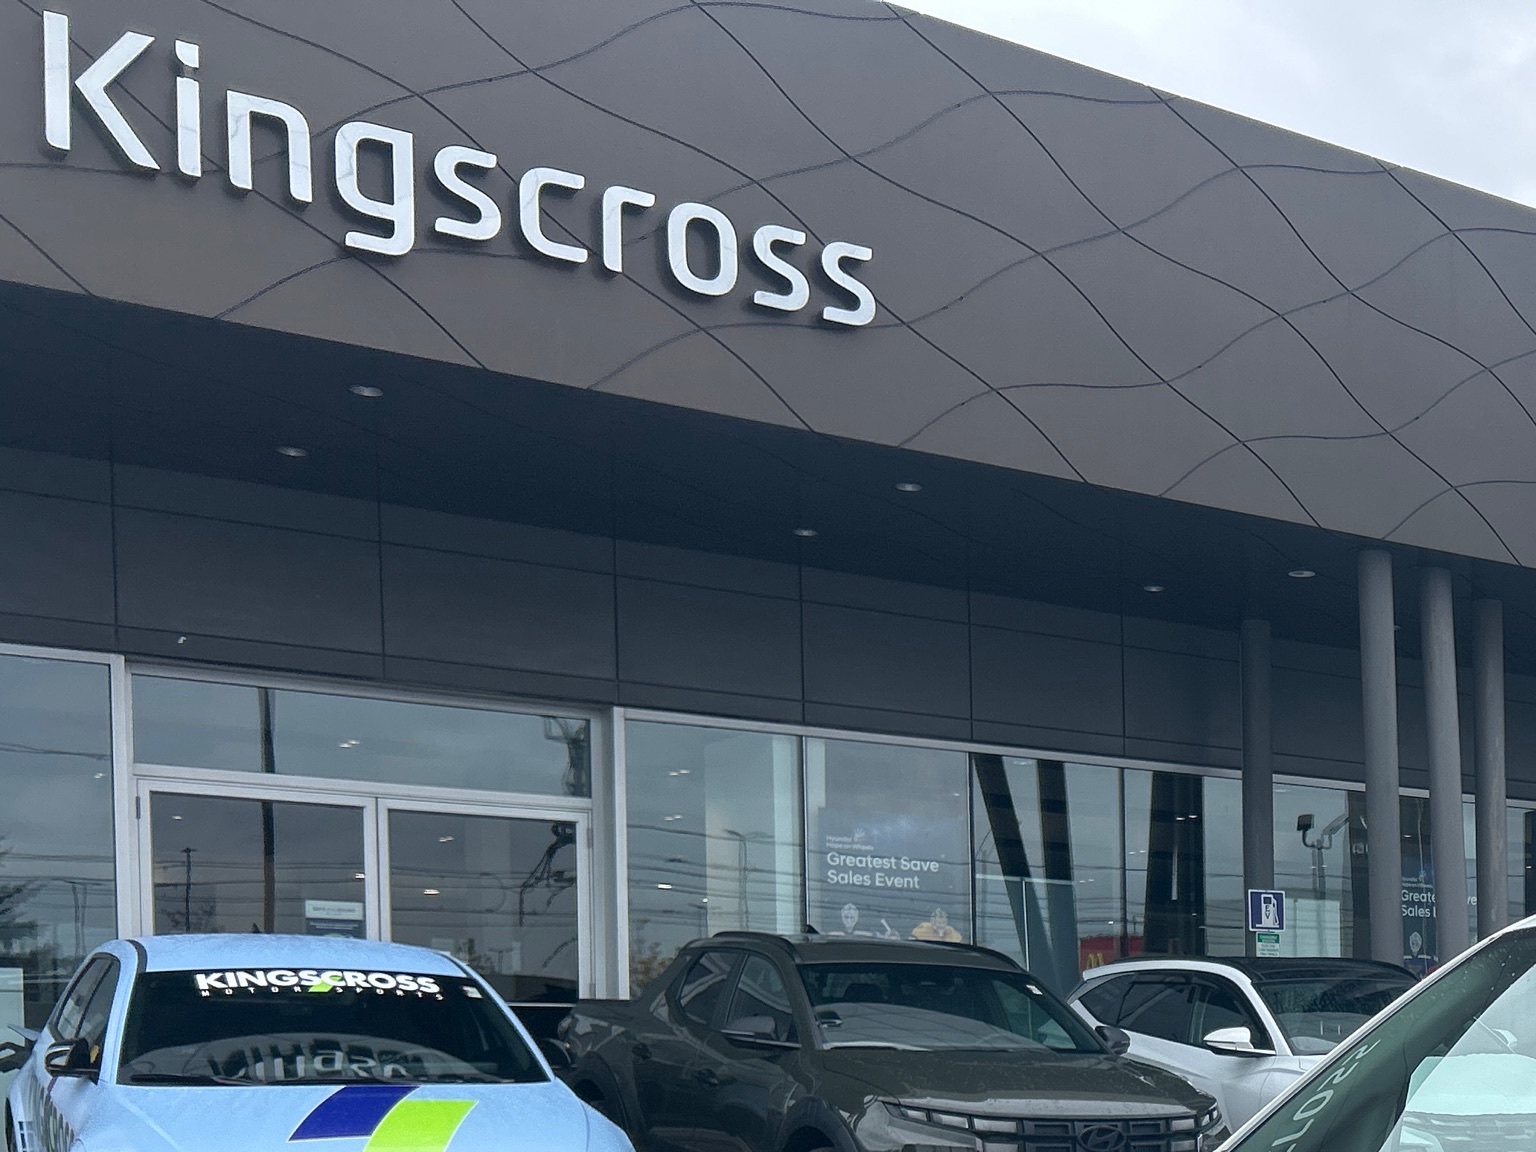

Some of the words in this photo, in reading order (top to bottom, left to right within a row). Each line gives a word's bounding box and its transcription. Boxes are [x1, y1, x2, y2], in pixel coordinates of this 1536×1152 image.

[42, 10, 876, 327] Kingscross
[827, 851, 897, 870] Greatest
[900, 856, 940, 873] Save
[827, 869, 871, 886] Sales
[875, 873, 920, 889] Event
[1401, 889, 1436, 904] Greate
[1265, 904, 1271, 920] EV
[1402, 904, 1431, 918] Sales
[196, 969, 440, 993] KINGSCROSS
